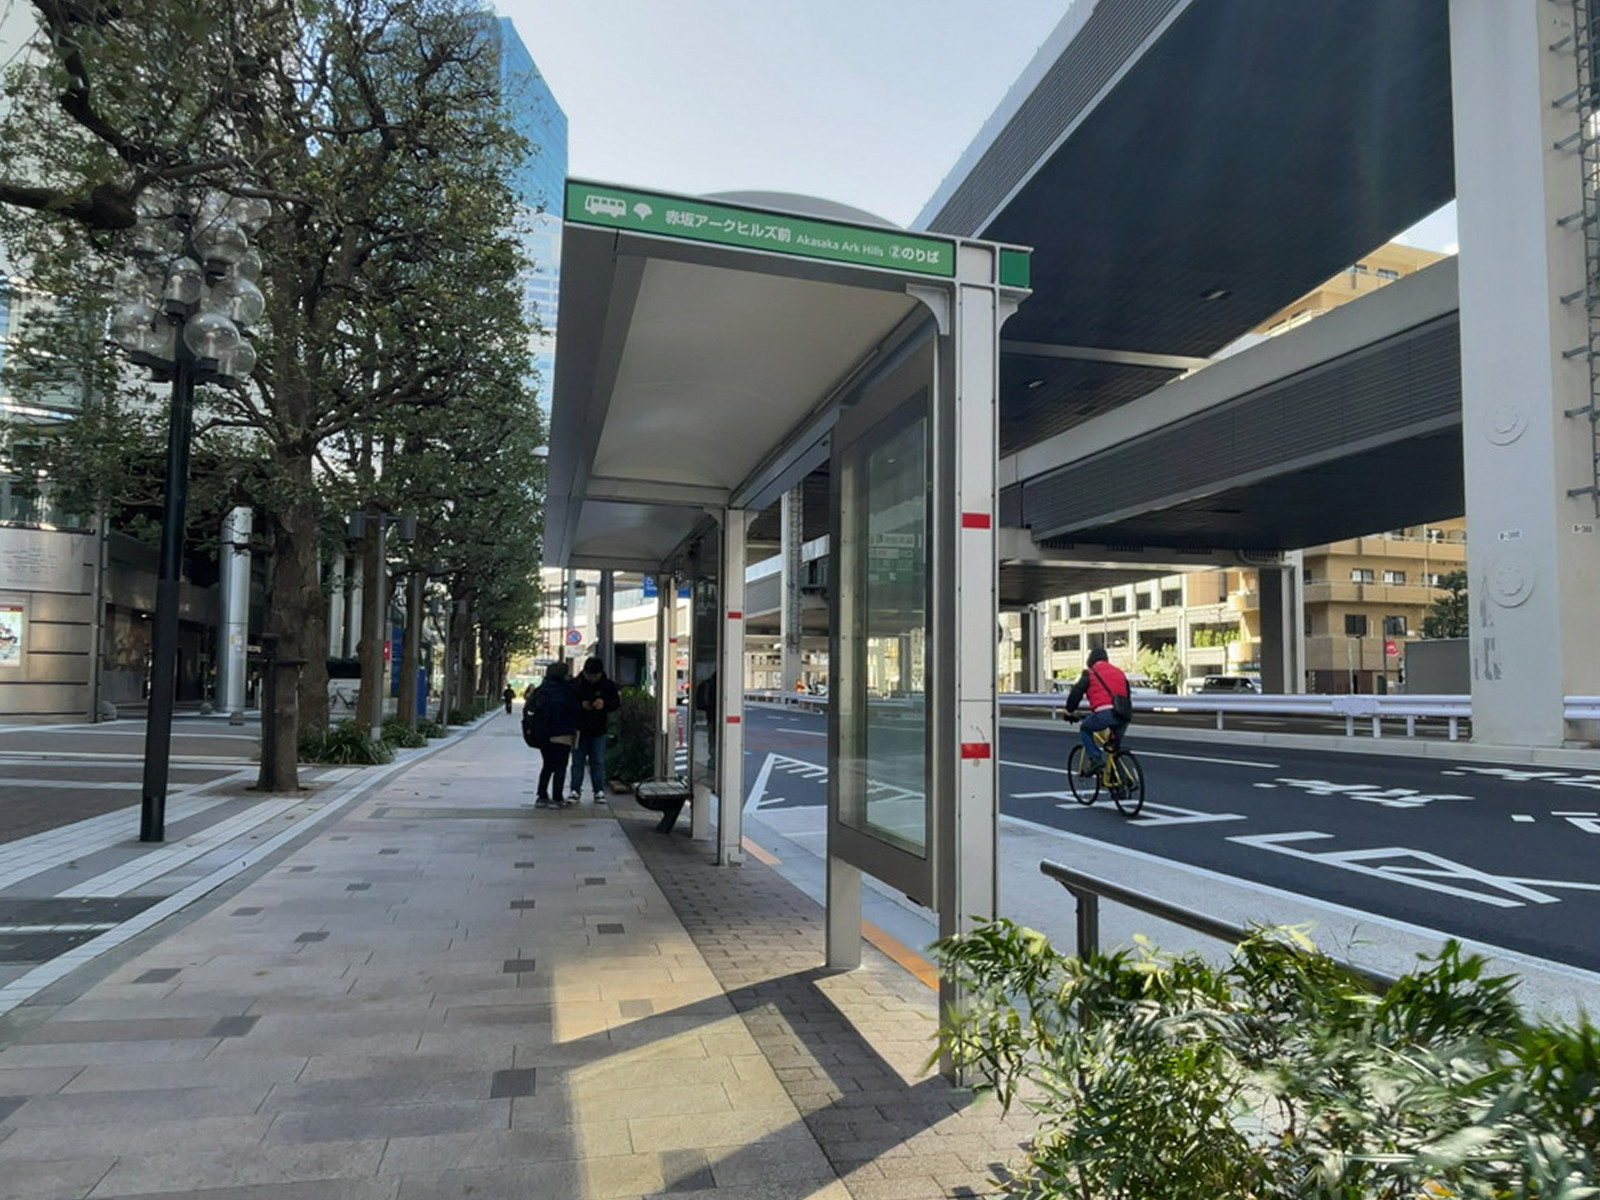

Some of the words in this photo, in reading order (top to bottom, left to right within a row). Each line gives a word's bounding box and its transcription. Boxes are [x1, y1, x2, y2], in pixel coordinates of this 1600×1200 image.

[665, 209, 791, 243] 赤坂アークヒルズ前
[796, 234, 839, 250] Akasaka
[842, 241, 860, 252] Ark
[863, 244, 884, 257] Hills
